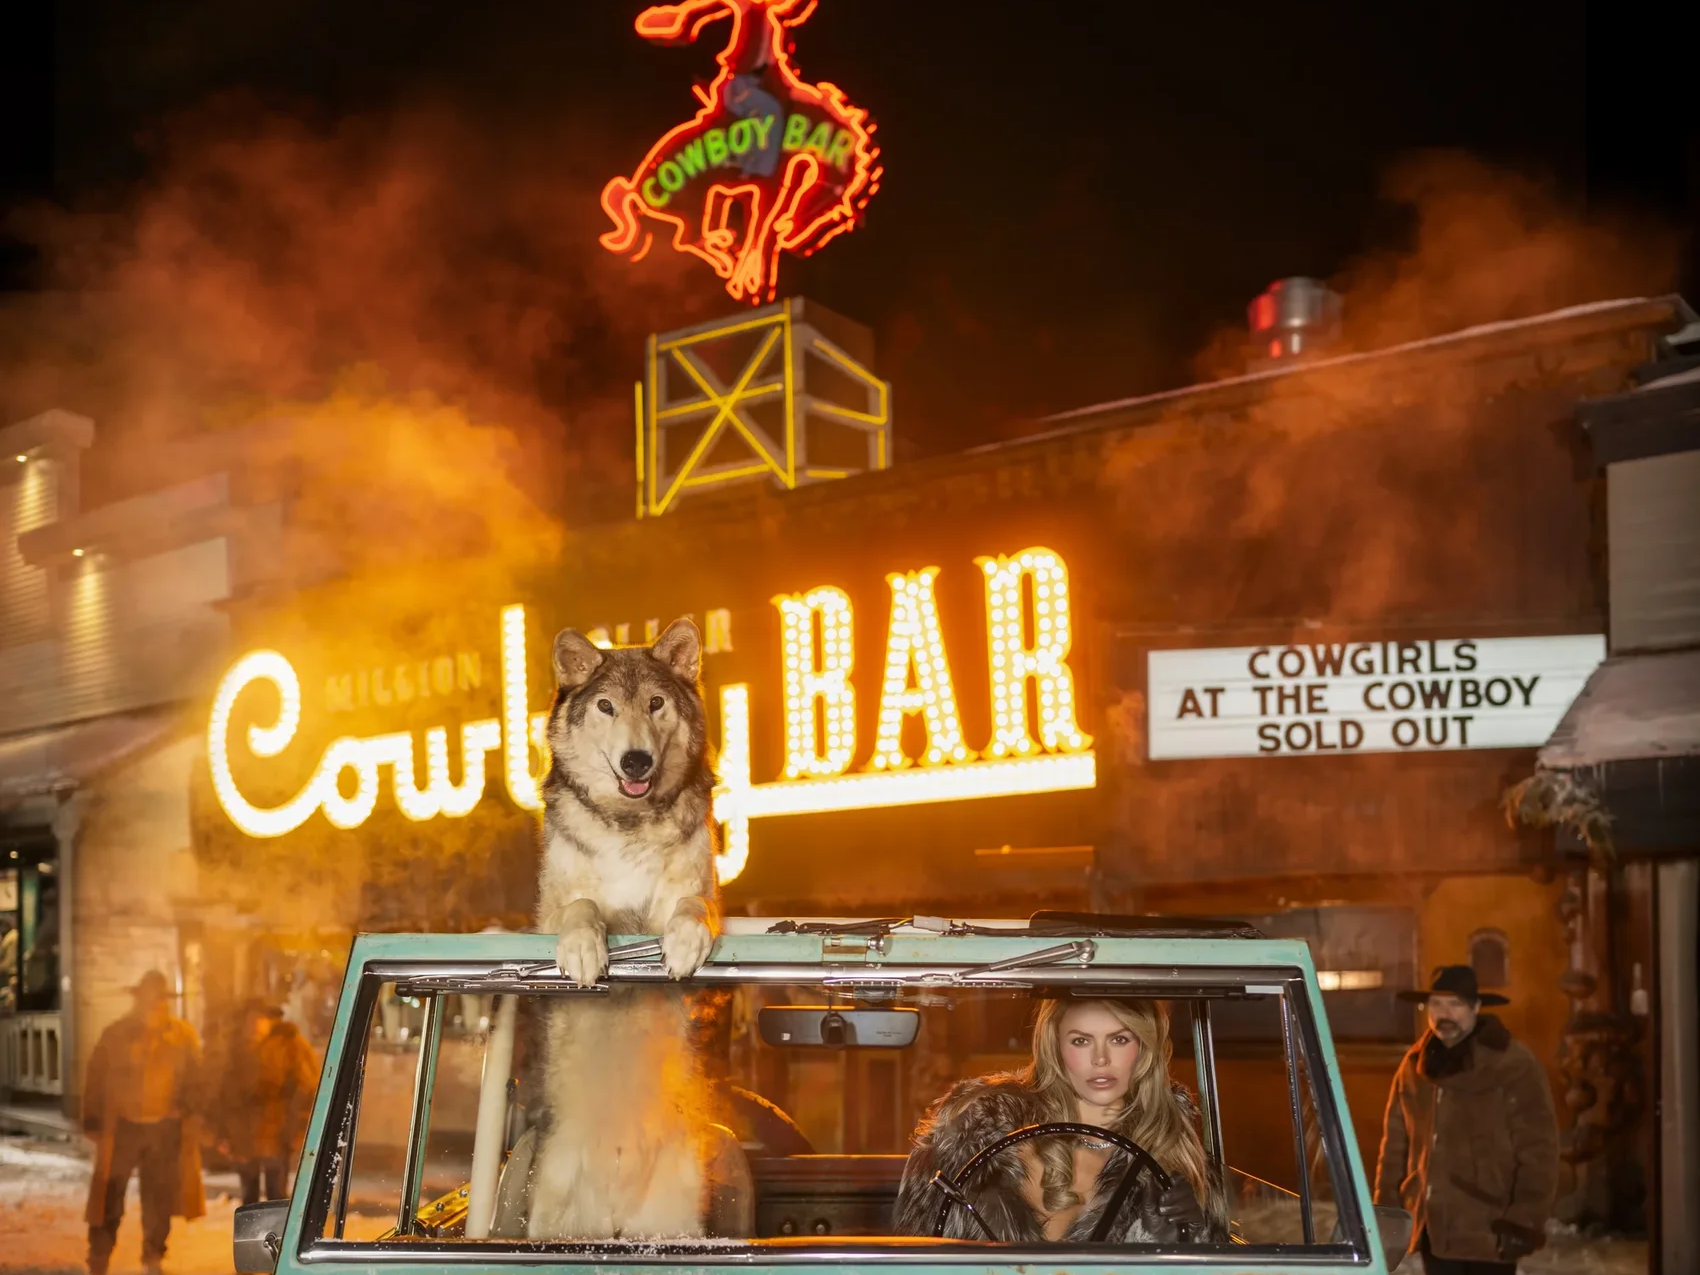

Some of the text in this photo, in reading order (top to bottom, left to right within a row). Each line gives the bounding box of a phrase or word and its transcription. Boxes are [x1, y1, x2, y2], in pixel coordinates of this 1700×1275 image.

[642, 113, 855, 207] COWBOY BAR
[324, 651, 482, 712] MILLION
[770, 546, 1095, 781] BAR
[1247, 639, 1478, 680] COWGIRLS
[1176, 676, 1541, 720] AT THE COWBOY
[1257, 715, 1475, 752] SOLD OUT
